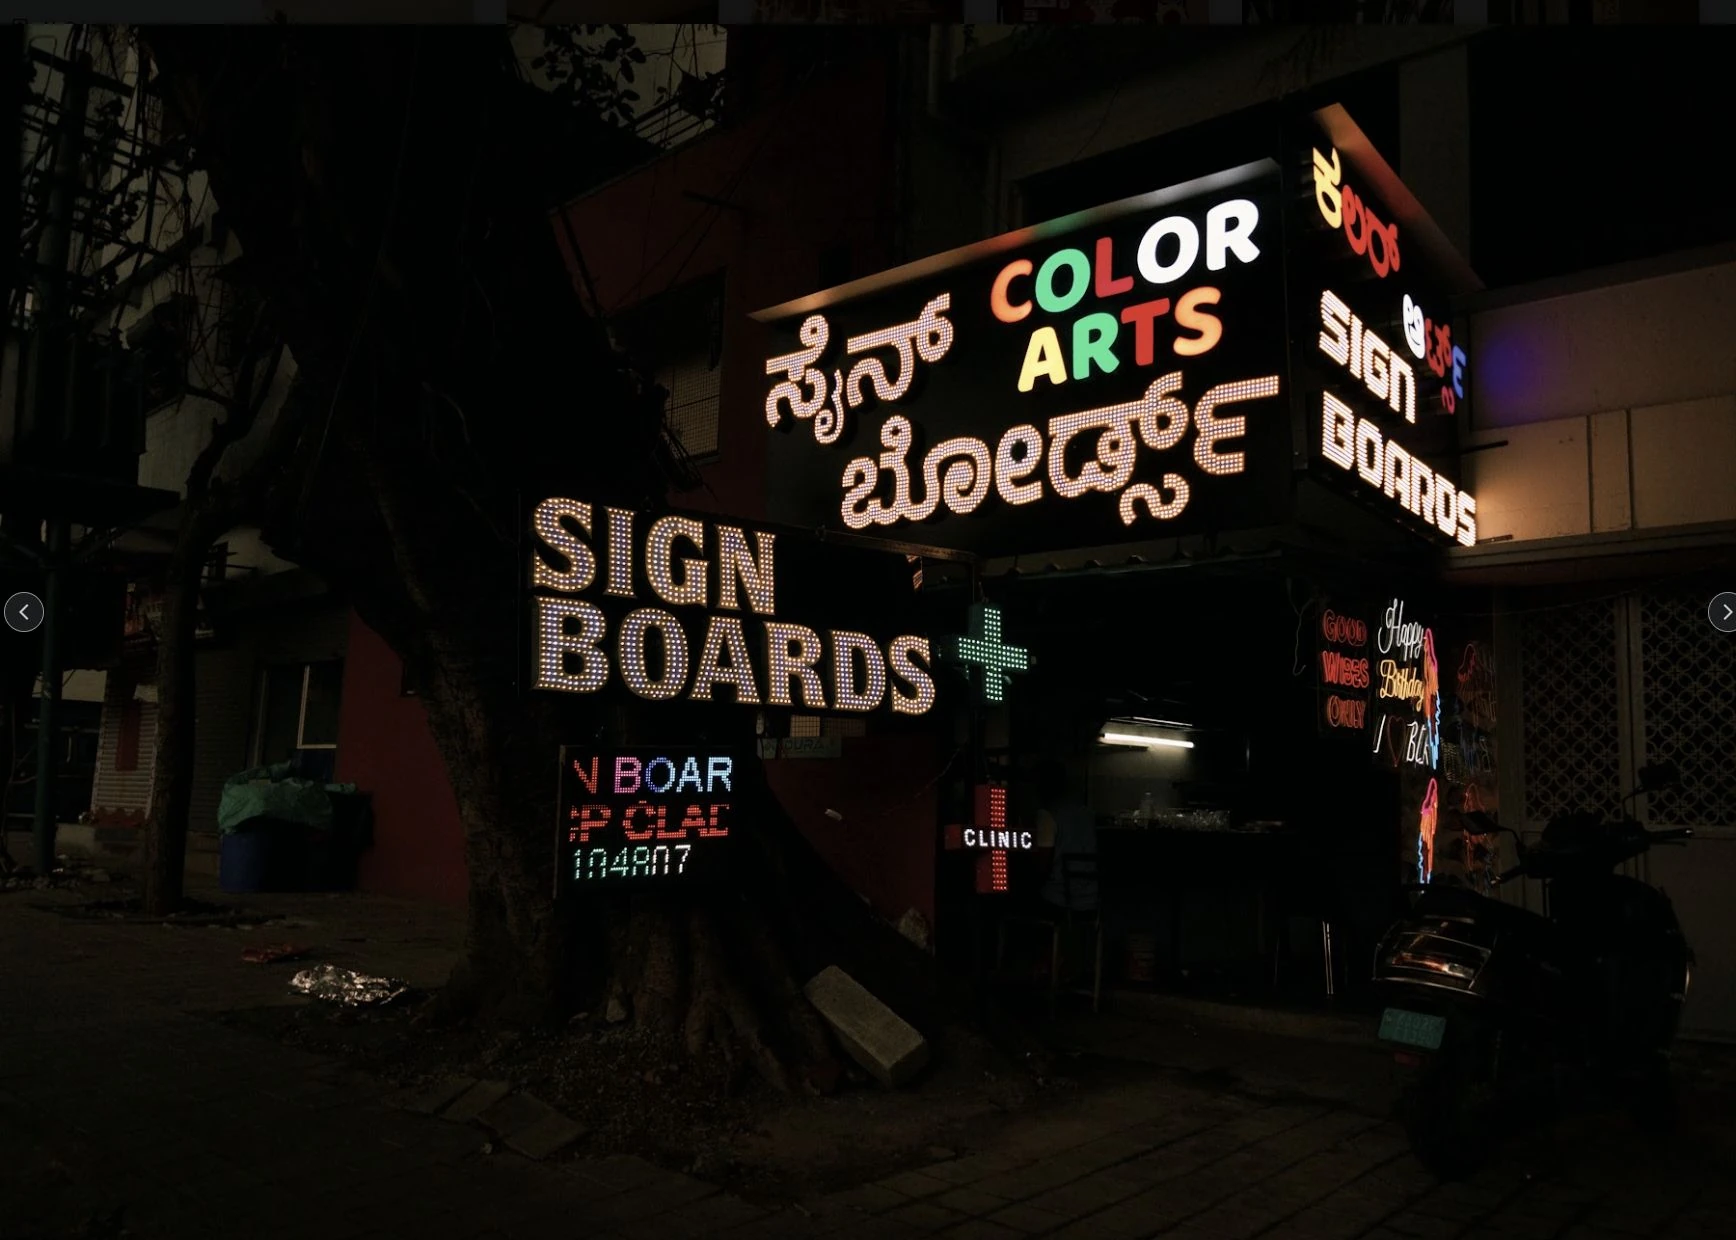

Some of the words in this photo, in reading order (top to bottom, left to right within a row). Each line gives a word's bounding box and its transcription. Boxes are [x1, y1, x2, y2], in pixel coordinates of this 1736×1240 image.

[991, 198, 1261, 324] COLOR
[765, 292, 954, 445] ಸೈನ್
[1017, 286, 1223, 393] ARTS
[1319, 289, 1416, 423] SIGN
[1322, 390, 1477, 547] BOARDS
[533, 497, 776, 616] SIGN
[532, 595, 937, 715] BOARDS
[1378, 598, 1427, 662] Happy
[1380, 659, 1426, 712] Birthday
[614, 756, 733, 794] BOAR
[963, 827, 1033, 850] CLINIC
